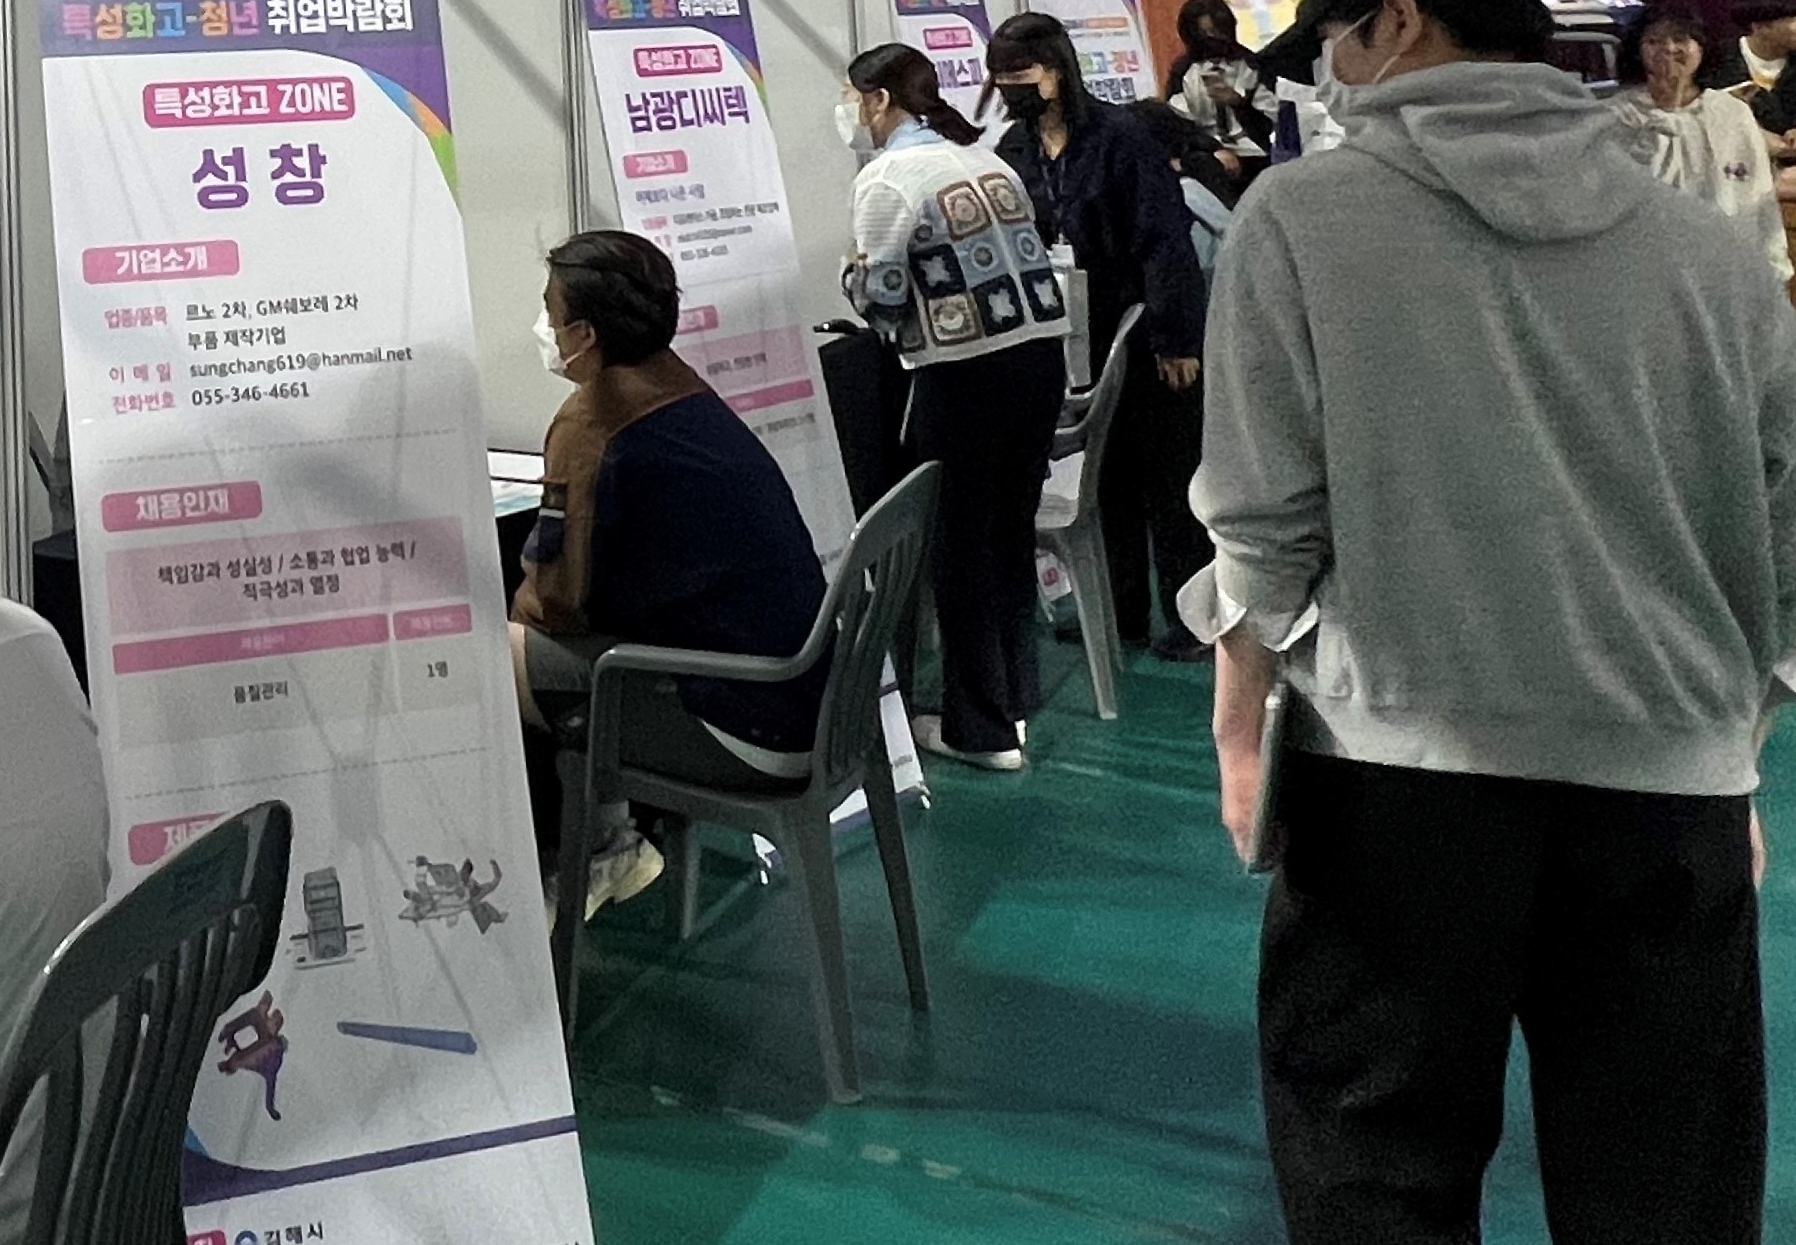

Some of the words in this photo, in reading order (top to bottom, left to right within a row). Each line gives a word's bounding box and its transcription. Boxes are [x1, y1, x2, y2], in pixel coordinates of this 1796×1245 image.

[152, 84, 271, 119] 특성화고
[276, 81, 349, 114] ZONE
[625, 85, 751, 133] 남광디씨텍
[115, 245, 208, 276] 기업소개
[221, 301, 252, 321] 2차,
[335, 293, 359, 312] 2차
[188, 330, 218, 351] 부품
[223, 326, 287, 348] 제작기업
[189, 346, 413, 378] sungchang619@hanmail.net
[192, 381, 310, 407] 055-346-4661
[135, 488, 229, 522] 채용인재
[310, 574, 340, 596] 열정
